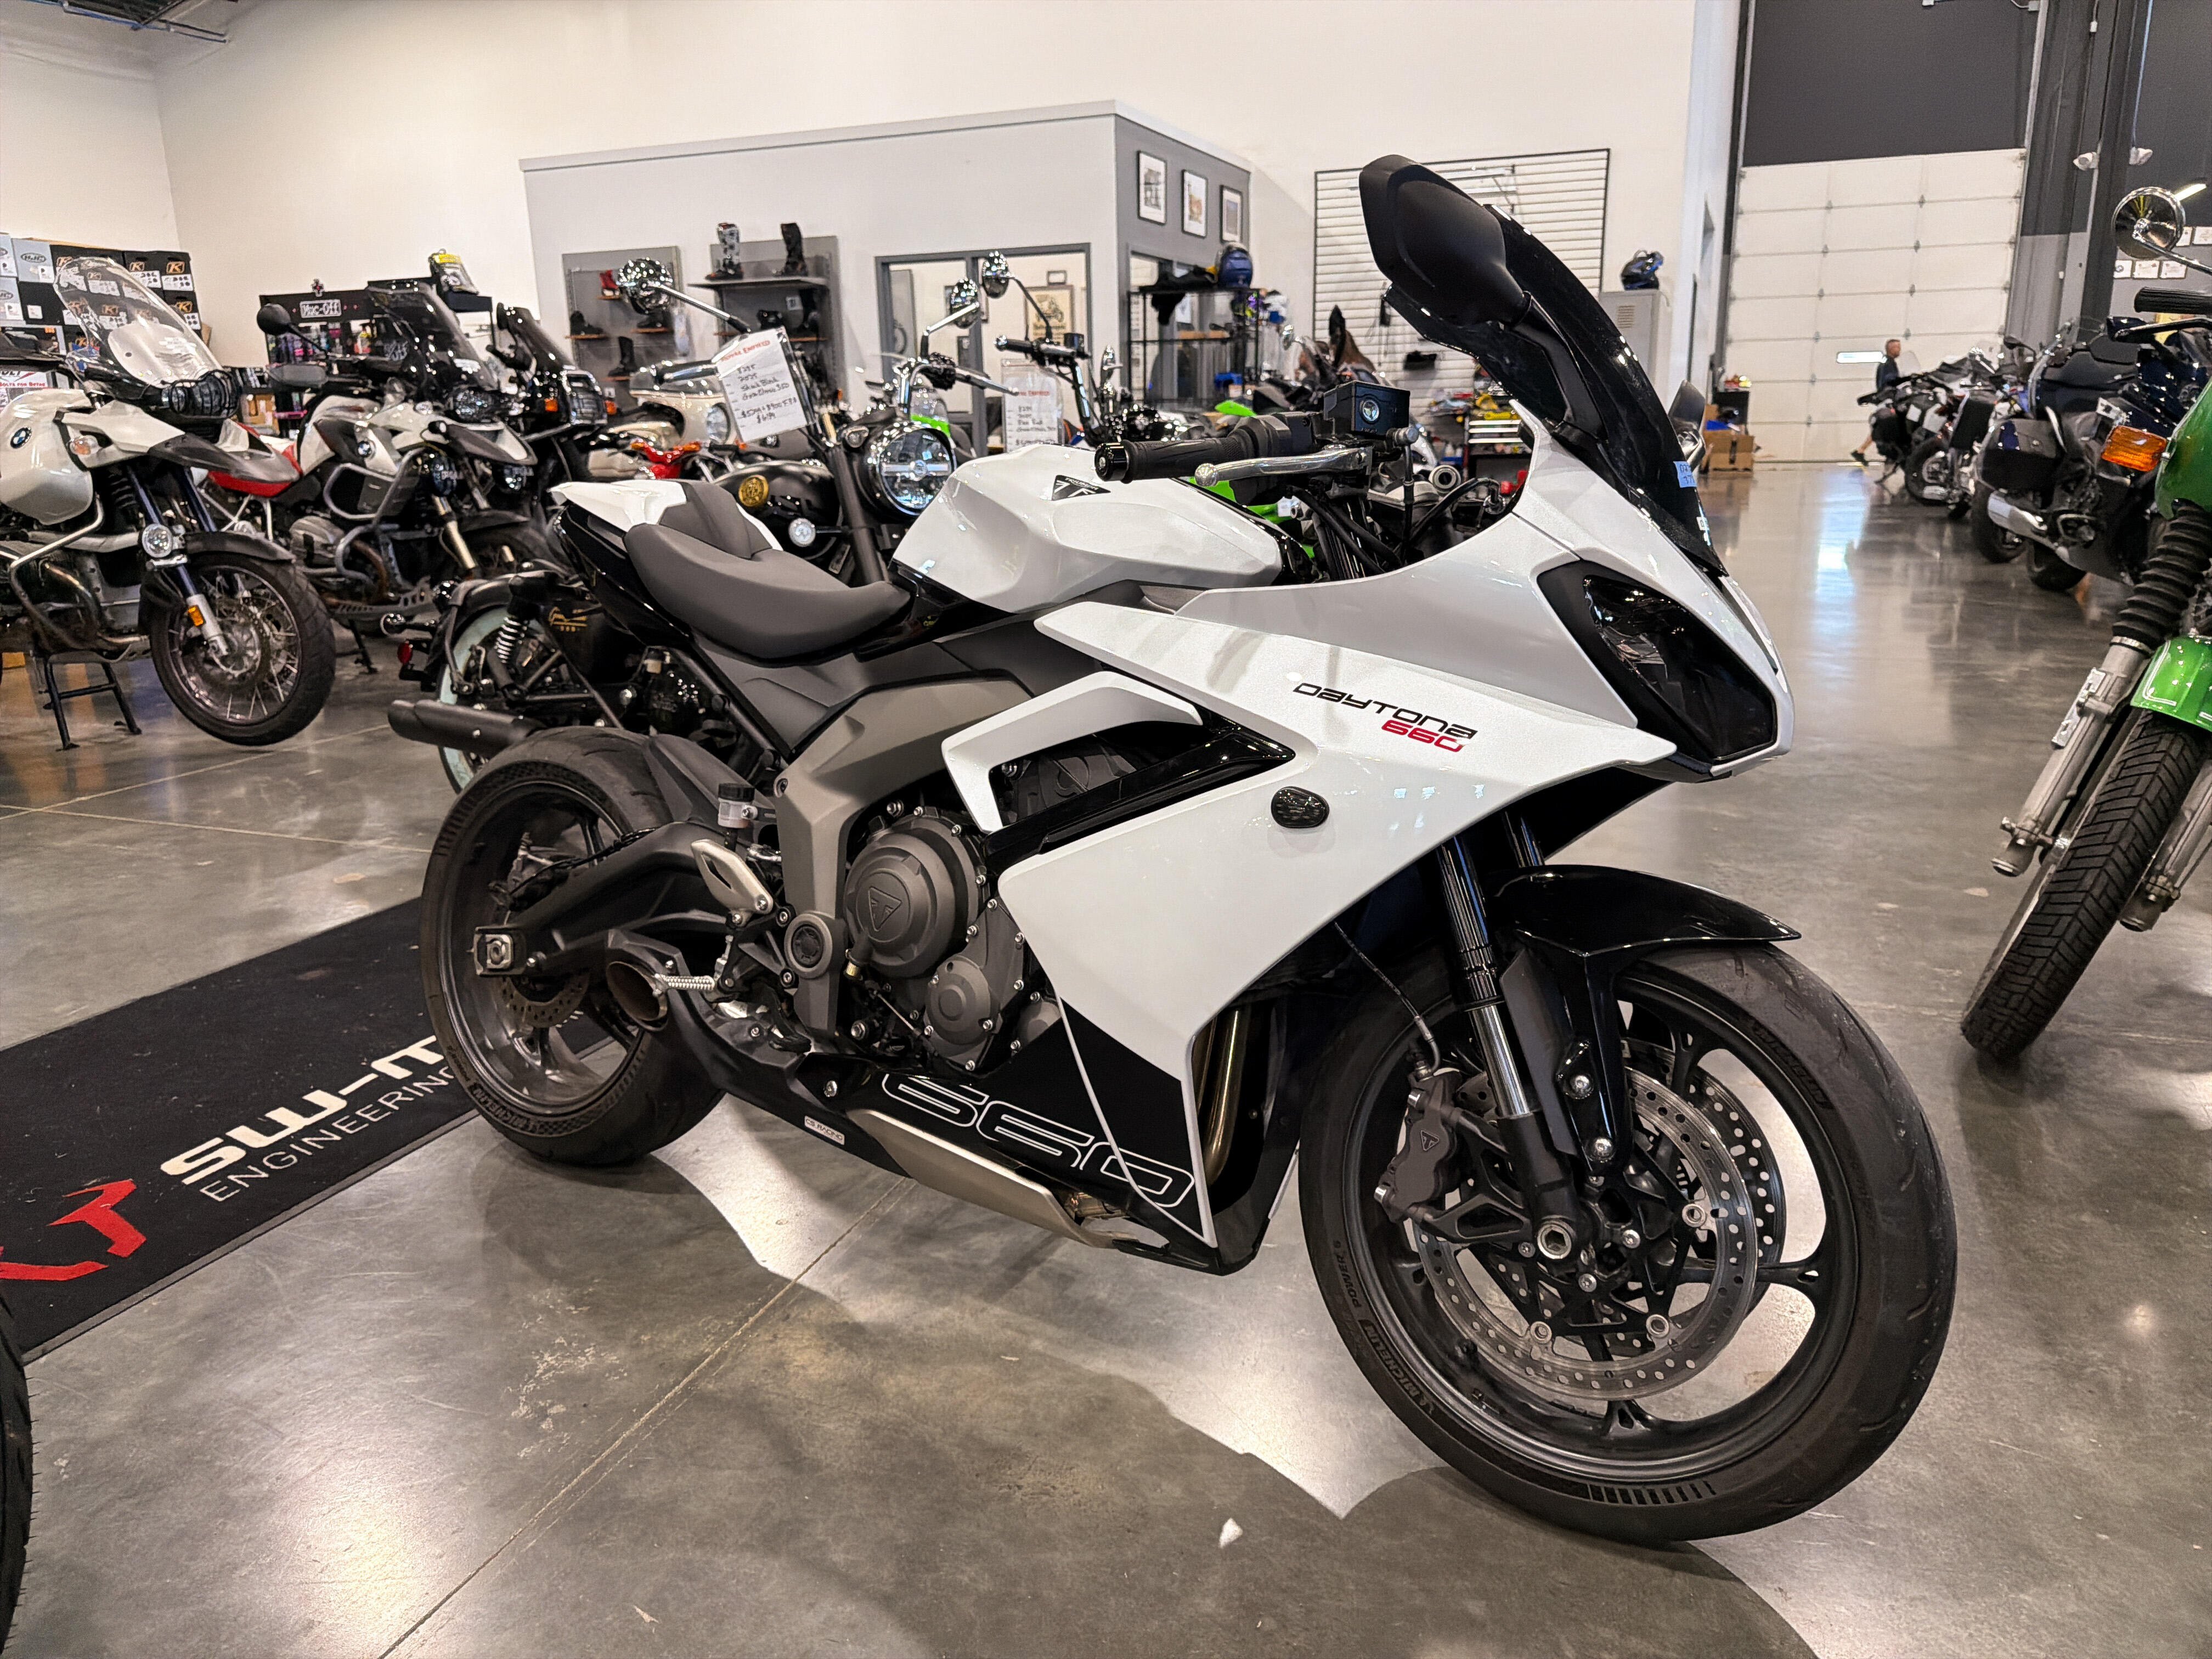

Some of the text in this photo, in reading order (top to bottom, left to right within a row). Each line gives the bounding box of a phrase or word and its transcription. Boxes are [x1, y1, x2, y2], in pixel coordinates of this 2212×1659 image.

[882, 1074, 1194, 1207] 660
[1336, 1254, 1362, 1309] POWER
[1364, 1322, 1422, 1401] MICHELIN
